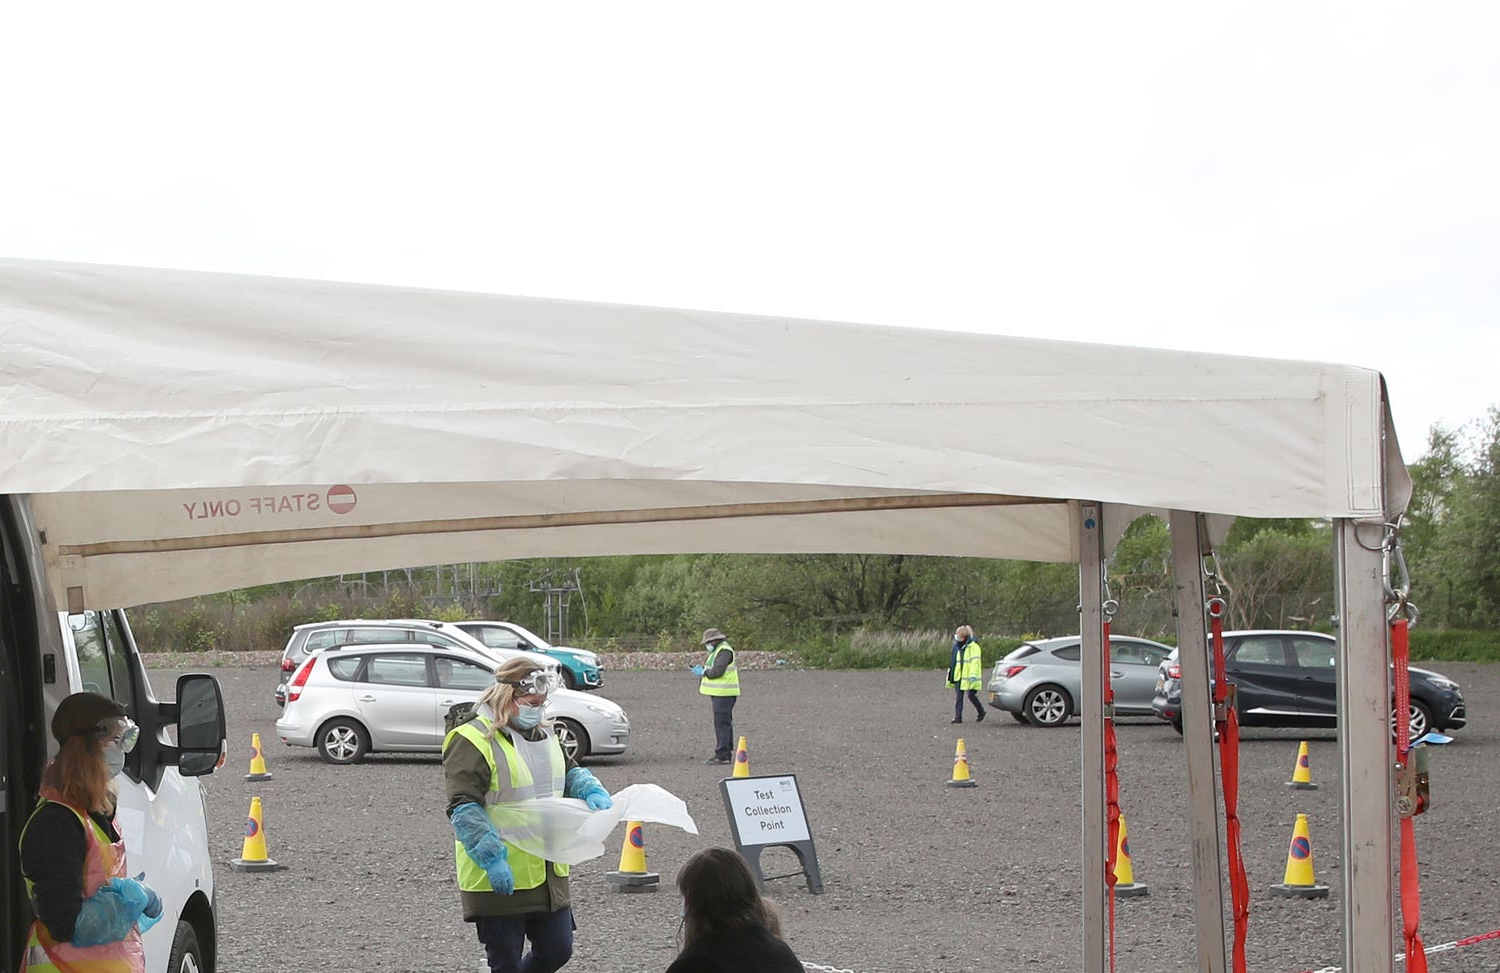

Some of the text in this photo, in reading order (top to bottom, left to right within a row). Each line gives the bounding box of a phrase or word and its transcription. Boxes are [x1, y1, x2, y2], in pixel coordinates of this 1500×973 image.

[754, 790, 774, 800] Test
[745, 805, 792, 816] Collection
[760, 820, 785, 831] Point
